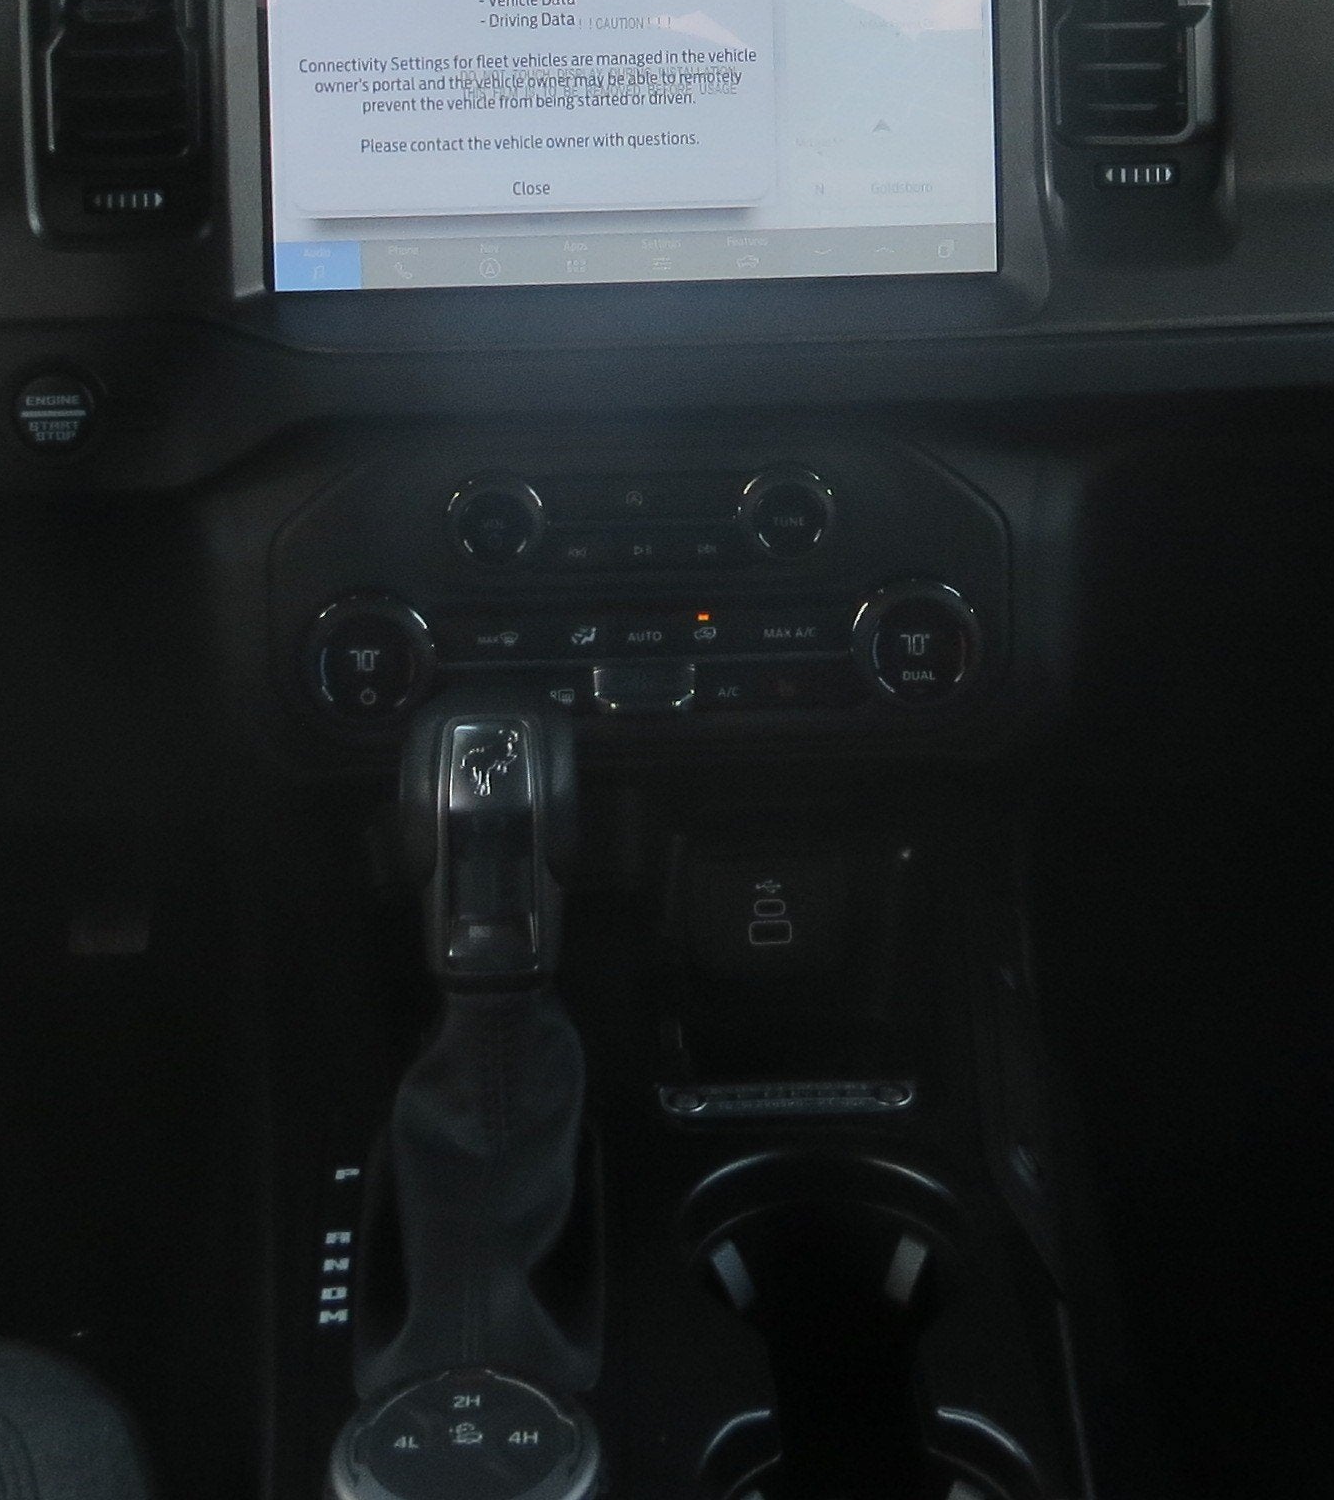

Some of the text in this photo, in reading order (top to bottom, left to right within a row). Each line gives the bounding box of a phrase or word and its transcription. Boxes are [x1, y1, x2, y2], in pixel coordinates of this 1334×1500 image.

[489, 12, 575, 29] Driving Data
[299, 48, 756, 74] Connectivity Settings for fleet vehicles are managed in the vehicle
[315, 68, 742, 93] owner's portal and the vehicle owner may be able to remotely
[362, 90, 696, 114] prevent the vehicle from being started or driven.
[361, 132, 700, 153] Please contact the vehicle owner with questions.
[512, 181, 550, 196] Close
[26, 395, 80, 406] ENGINE
[773, 516, 805, 527] TUNE
[628, 631, 663, 642] AUTO
[763, 626, 817, 639] MAX A/C
[902, 670, 935, 681] DUAL
[718, 686, 740, 698] A/C
[323, 1257, 350, 1272] N
[319, 1308, 349, 1324] M
[453, 1395, 480, 1408] 2H
[394, 1436, 418, 1449] 4L
[508, 1430, 538, 1444] 4H
